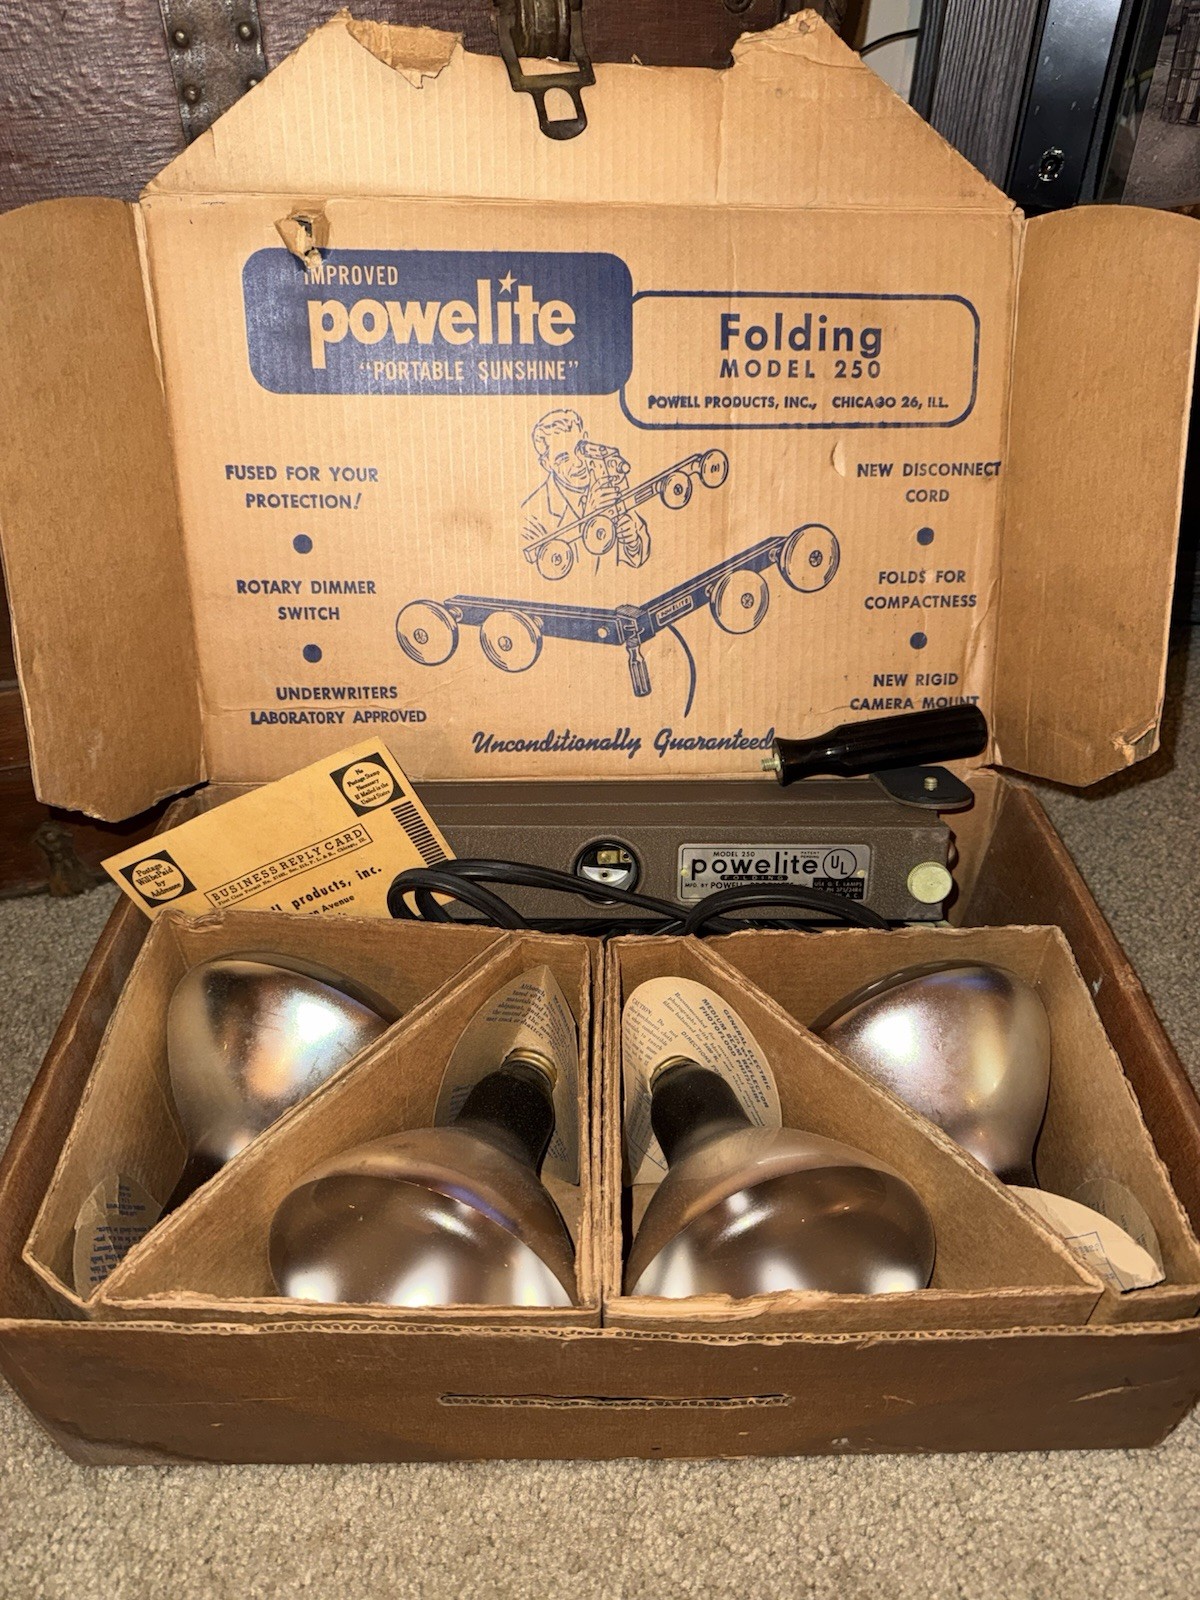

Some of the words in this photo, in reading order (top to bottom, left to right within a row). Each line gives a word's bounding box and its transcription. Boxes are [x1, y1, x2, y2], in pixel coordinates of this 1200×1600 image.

[304, 264, 399, 286] IMPROVED
[307, 271, 577, 370] powelite
[719, 312, 883, 359] Folding
[719, 358, 816, 379] MODEL
[834, 359, 882, 379] 250
[647, 395, 701, 410] POWELL
[704, 395, 779, 411] PRODUCTS,
[901, 395, 923, 411] 26,
[927, 395, 949, 409] ILL.
[225, 464, 278, 481] FUSED
[285, 466, 321, 482] FOR
[328, 466, 379, 482] YOUR
[857, 462, 894, 478] NEW
[902, 460, 1002, 477] DISCONNECT
[245, 492, 362, 510] PROTECTION!
[905, 488, 950, 503] CORD
[878, 569, 926, 585] FOLDS
[935, 569, 966, 584] FOR
[236, 579, 302, 595] ROTARY
[310, 580, 377, 595] DIMMER
[864, 594, 978, 610] COMPACTNESS
[277, 606, 341, 621] SWITCH
[873, 673, 909, 687] NEW
[915, 673, 959, 686] RIGID
[275, 686, 398, 701] UNDERWRITERS
[849, 697, 915, 711] CAMERA
[250, 710, 346, 726] LABORATORY
[352, 709, 428, 724] APPROVED
[471, 726, 642, 760] Unconditionally
[653, 726, 776, 759] Guaranteed
[135, 863, 163, 877] Postage
[211, 865, 279, 901] BUSINESS
[279, 846, 322, 871] REPLY
[324, 829, 363, 851] CARD
[691, 851, 819, 881] powelite
[291, 879, 352, 911] products,
[355, 866, 383, 881] inc.
[321, 895, 355, 913] Avenue
[698, 1005, 737, 1057] PHOTOFLOOD
[680, 1030, 712, 1064] DIRECTIONS
[701, 997, 727, 1031] MEDIUM
[726, 1033, 743, 1056] BEAM
[741, 1058, 770, 1109] REFLECTOR
[723, 1008, 747, 1046] GENERAL
[747, 1049, 772, 1091] ELECTRIC
